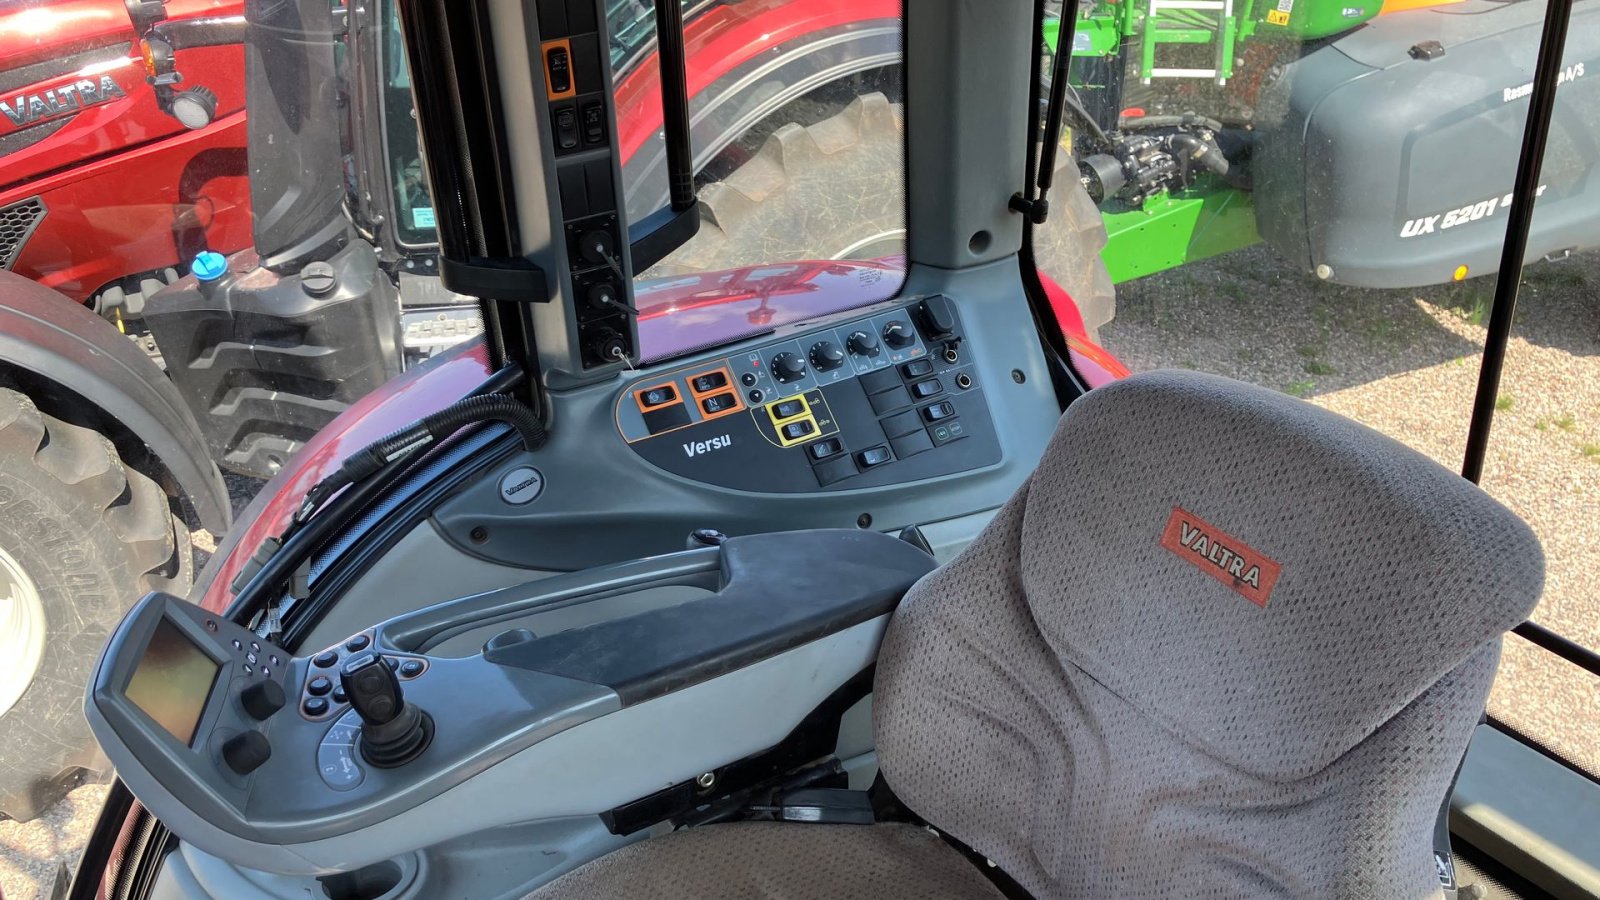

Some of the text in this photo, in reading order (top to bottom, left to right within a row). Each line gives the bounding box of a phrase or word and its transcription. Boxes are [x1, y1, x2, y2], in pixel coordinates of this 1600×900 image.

[0, 75, 126, 126] VALTRA
[1400, 197, 1499, 238] UX 5201
[682, 434, 732, 458] Versu
[1179, 520, 1260, 590] VALTRA
